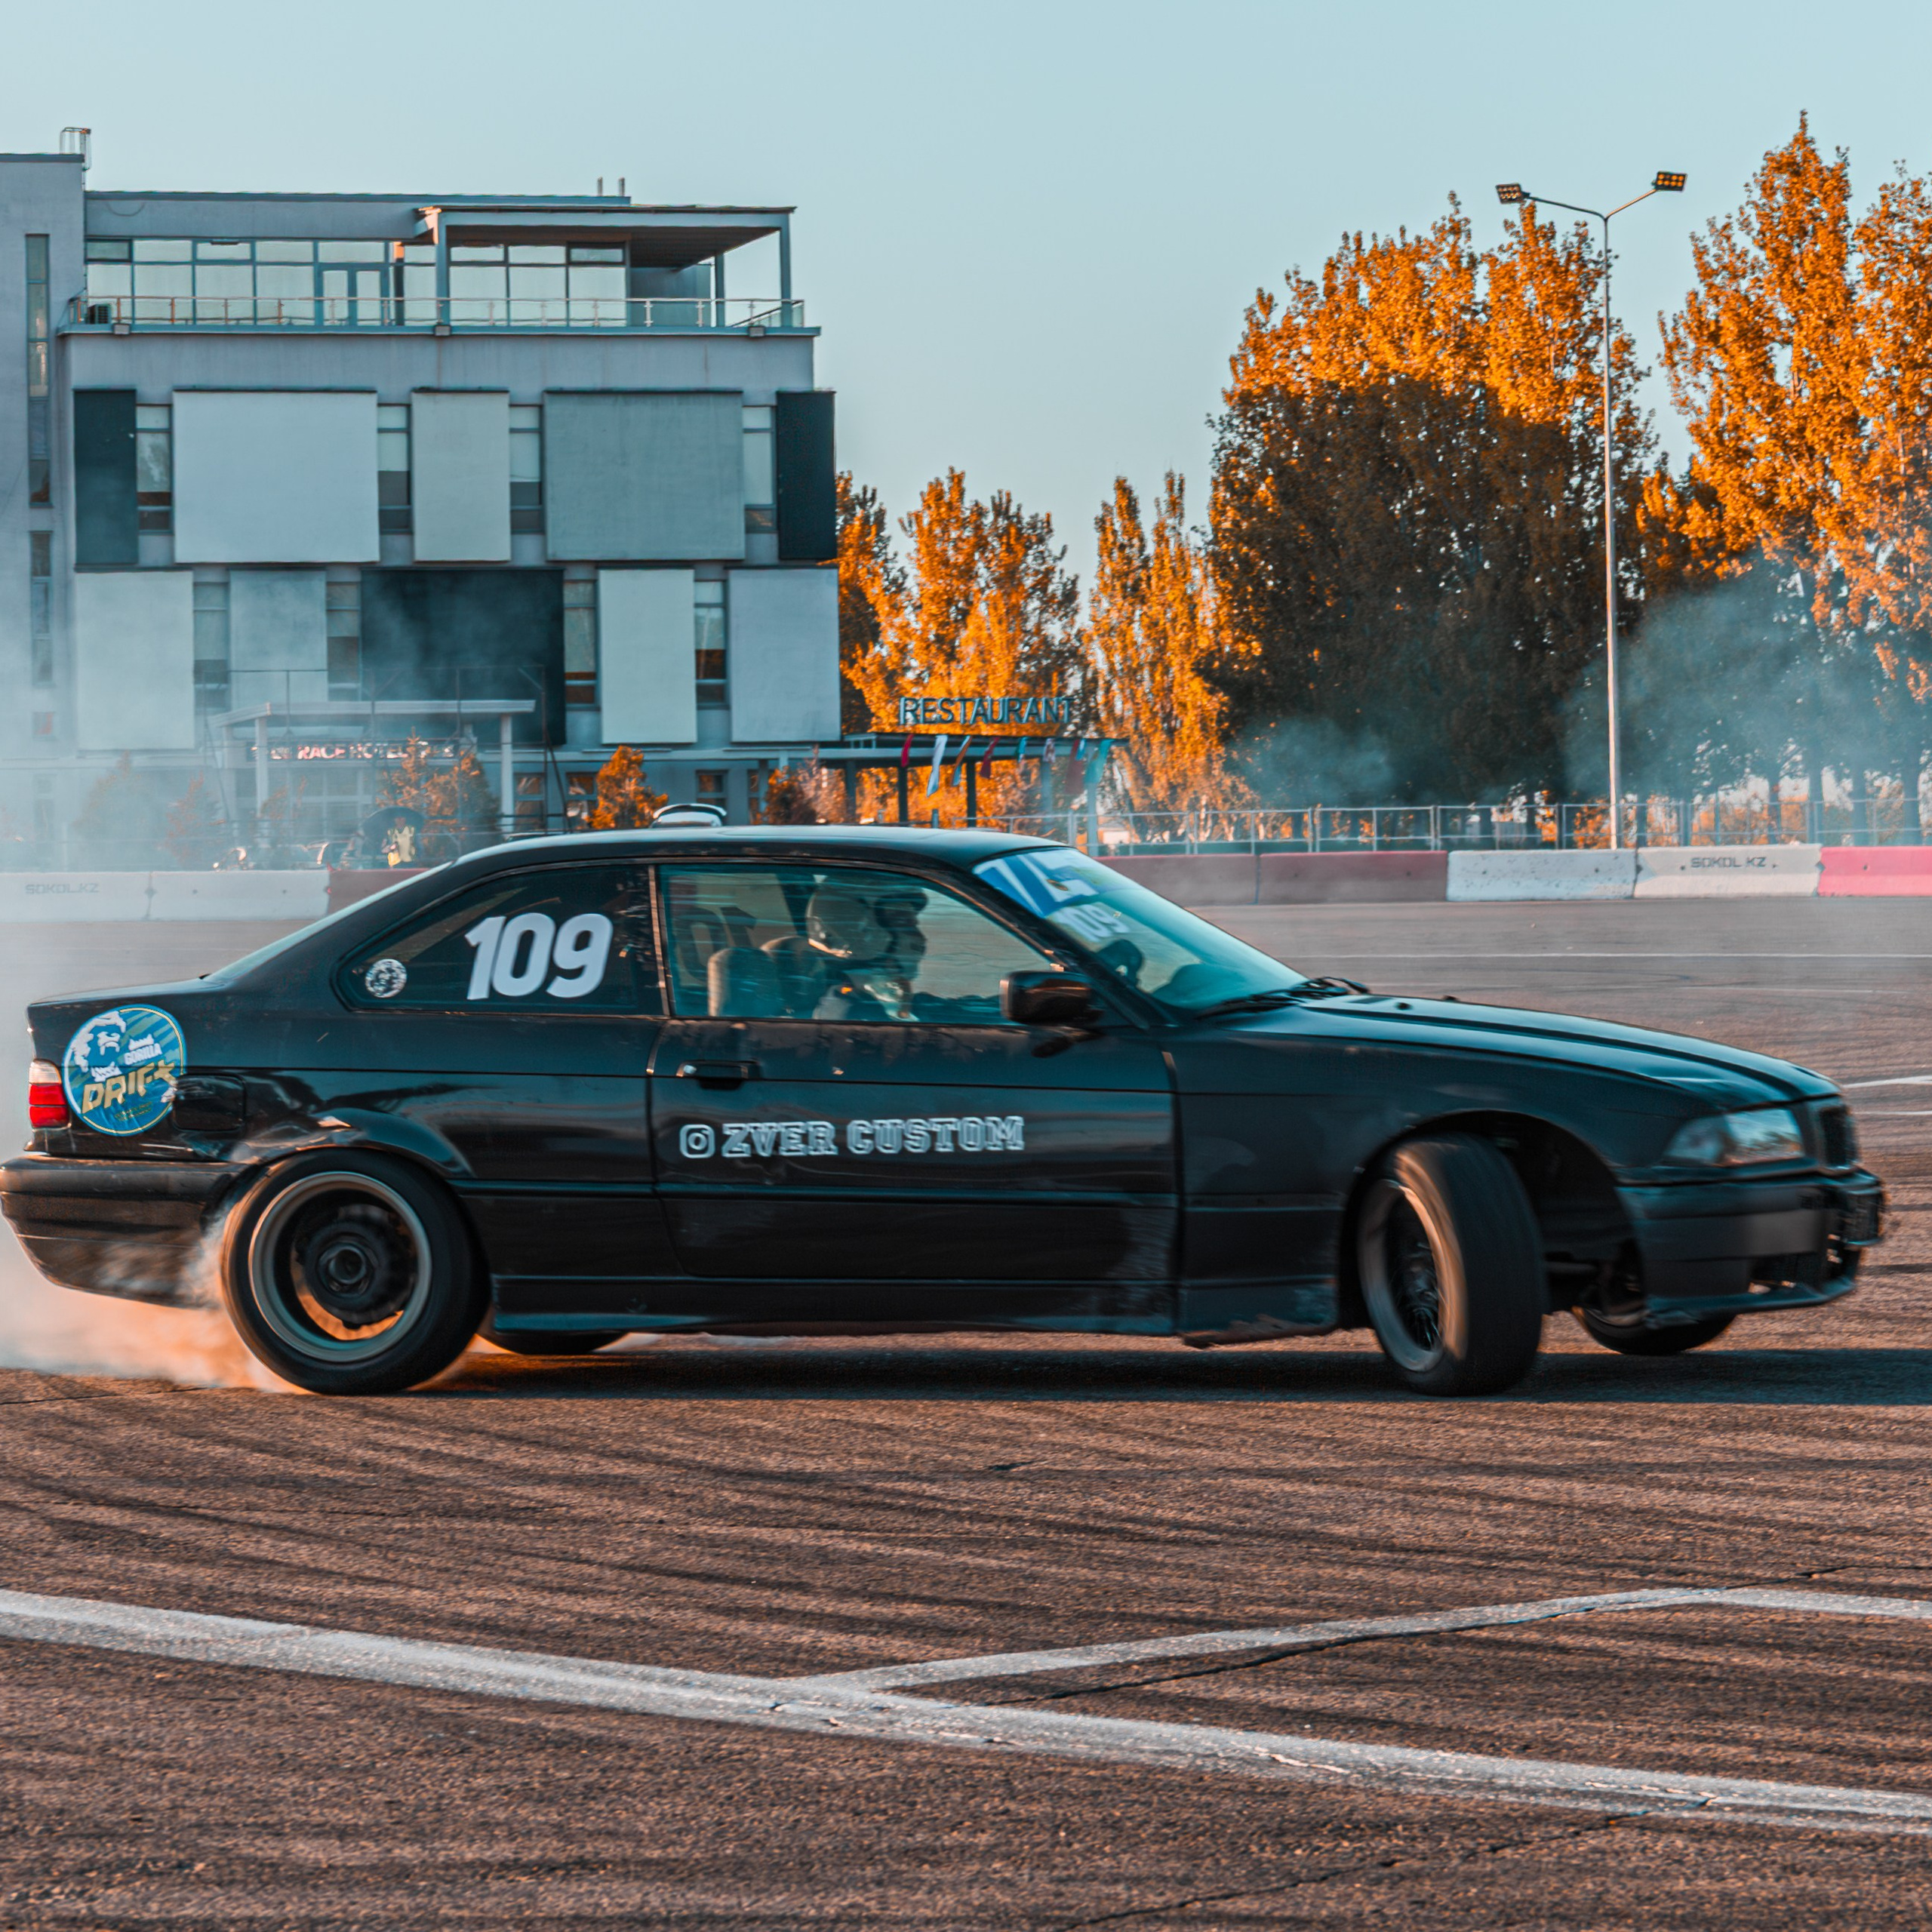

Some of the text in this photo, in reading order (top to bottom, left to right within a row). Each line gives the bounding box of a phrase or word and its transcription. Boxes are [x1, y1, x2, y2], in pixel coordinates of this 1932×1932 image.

[899, 697, 1075, 724] RESTAURANT
[297, 743, 346, 760] RACE
[464, 912, 614, 1000] 109
[124, 1042, 163, 1066] GORILLA
[721, 1115, 1025, 1158] ZVER CUSTOM
